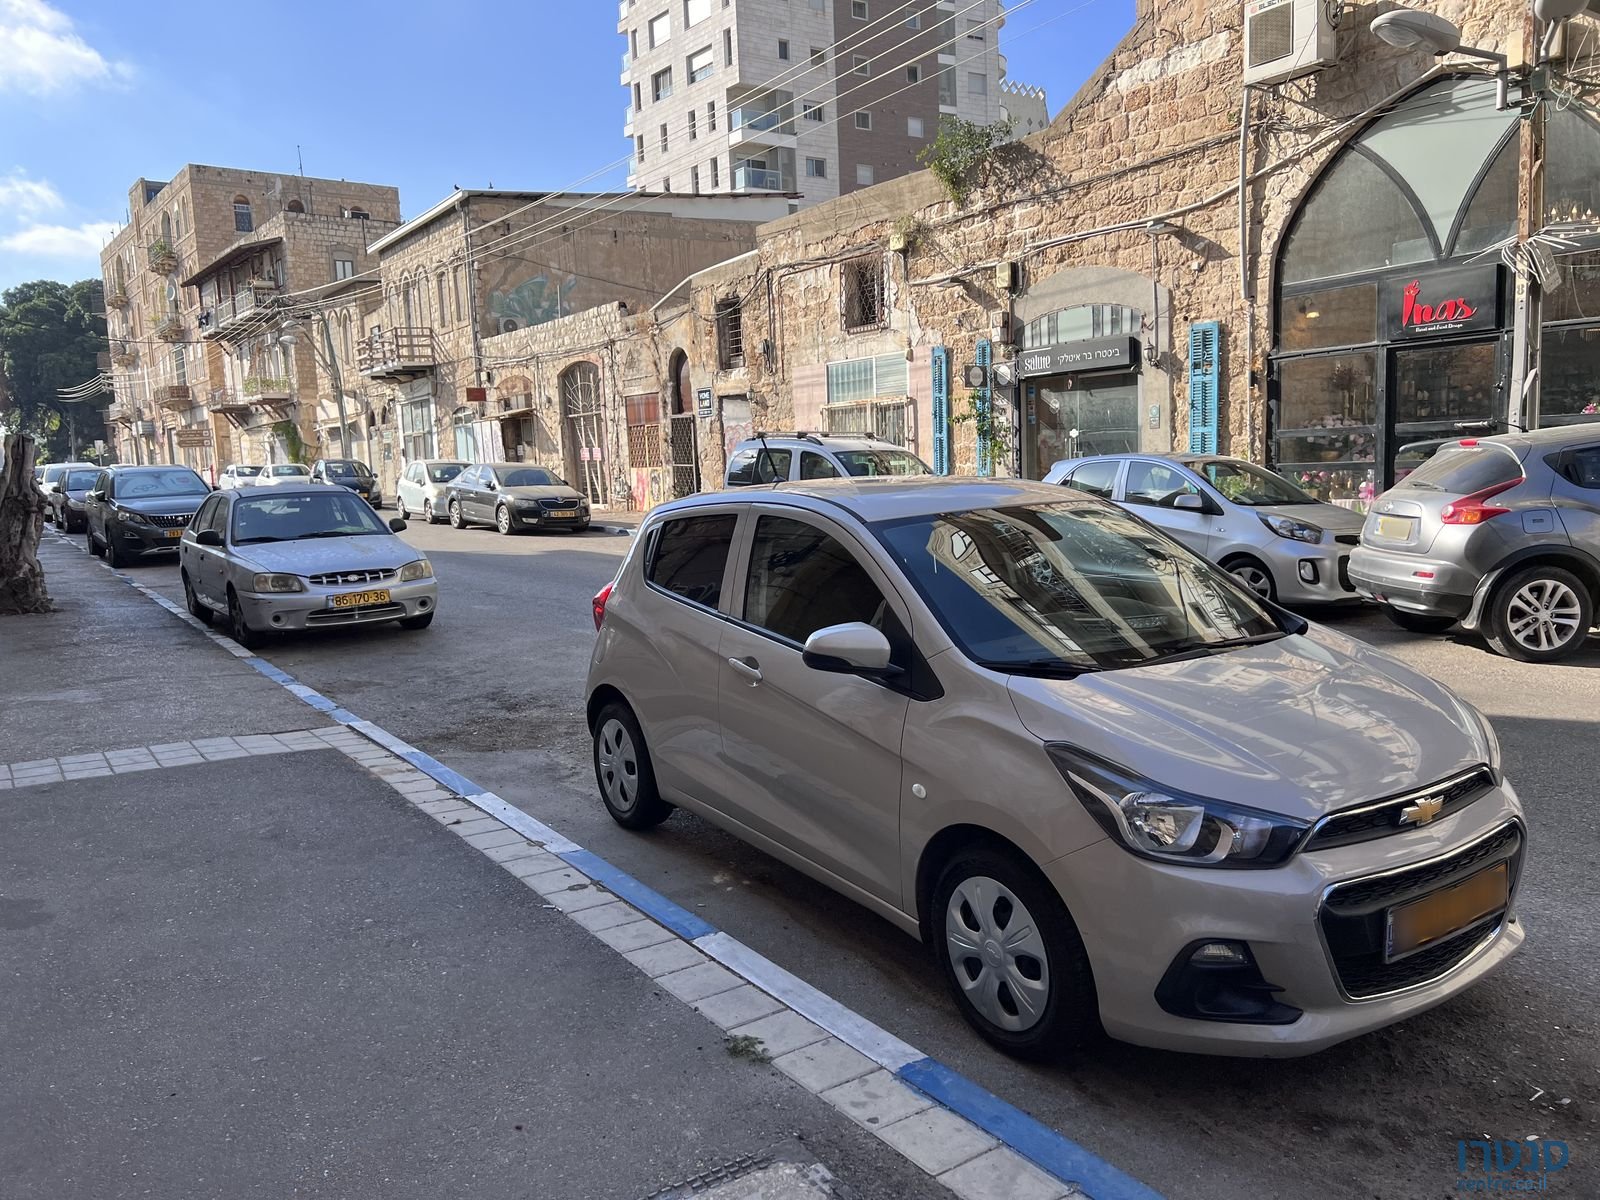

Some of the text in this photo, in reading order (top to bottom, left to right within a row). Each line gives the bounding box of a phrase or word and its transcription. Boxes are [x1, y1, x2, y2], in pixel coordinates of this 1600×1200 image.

[1057, 348, 1120, 366] ביסטרו בר איטלקי
